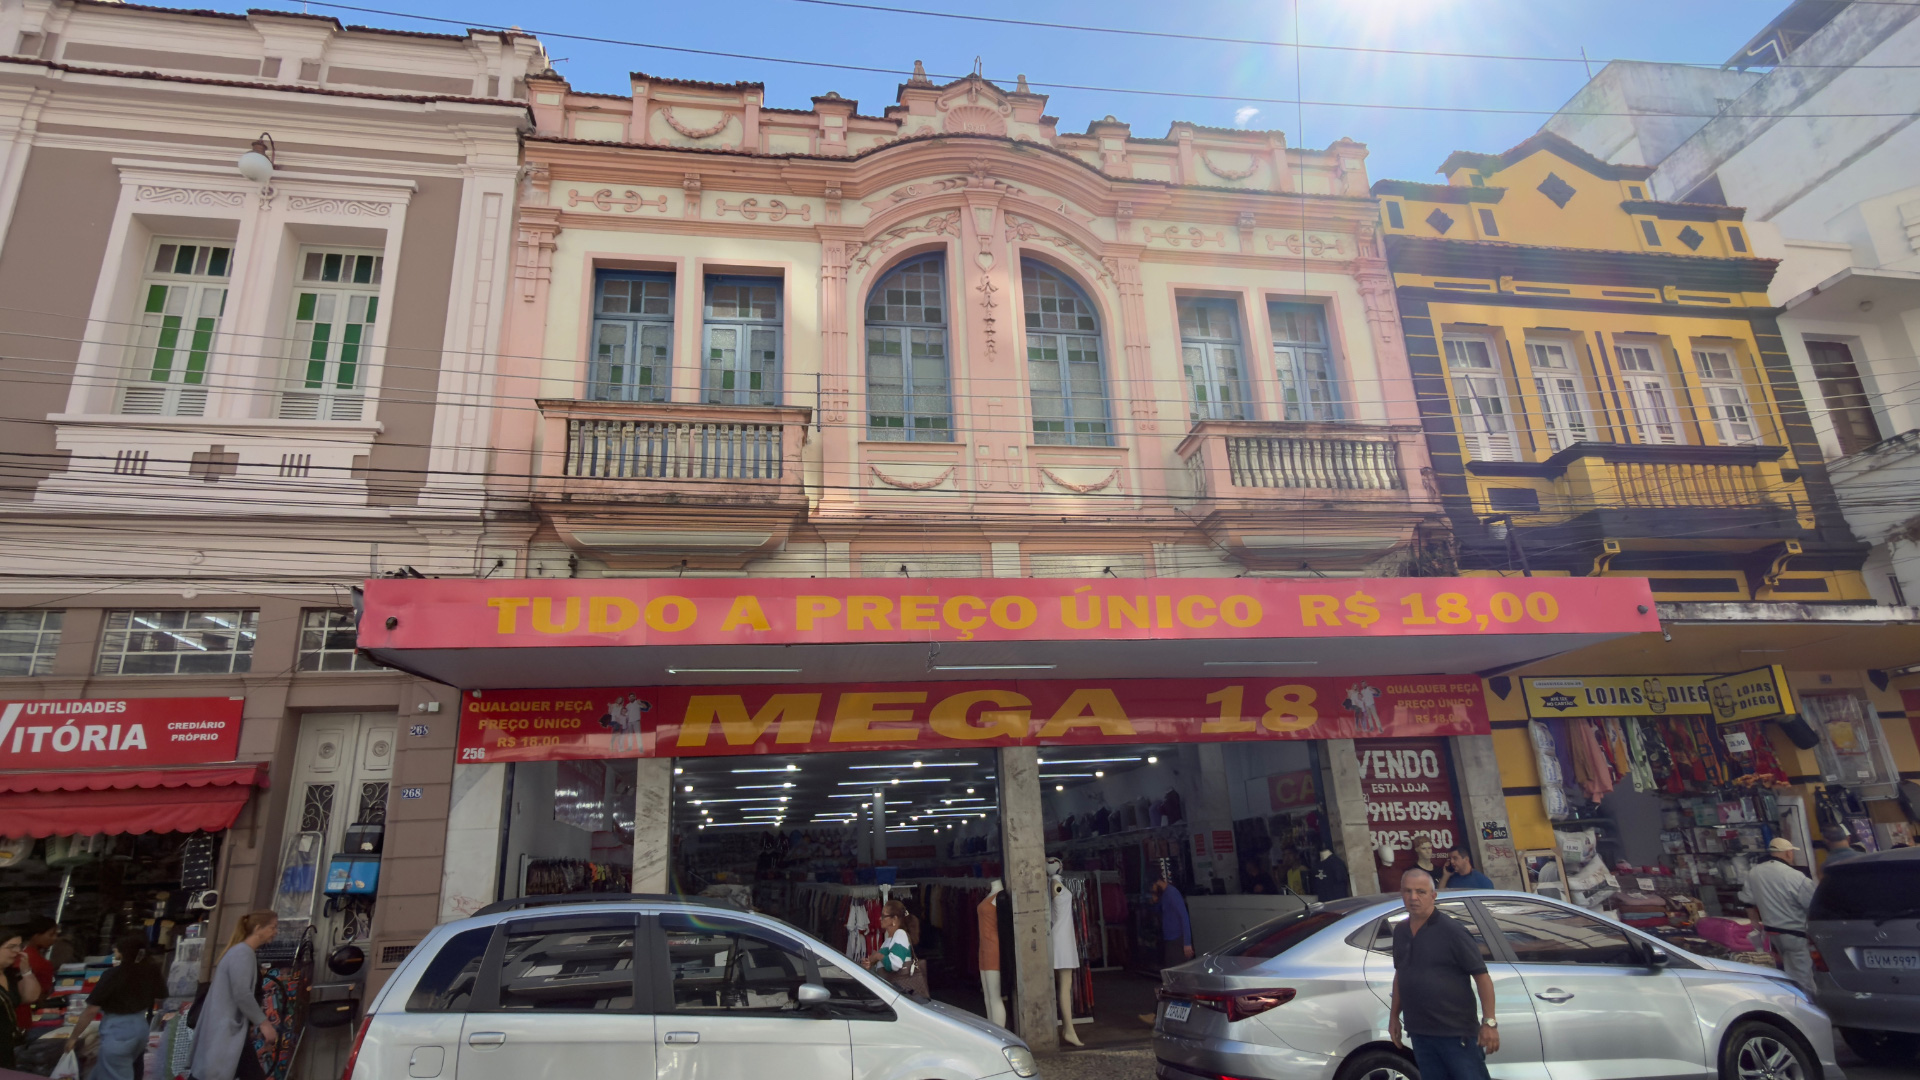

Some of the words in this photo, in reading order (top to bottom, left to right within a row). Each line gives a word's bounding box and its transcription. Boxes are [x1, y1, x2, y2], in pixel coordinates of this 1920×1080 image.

[487, 595, 698, 634] TUDO
[720, 595, 772, 632] A
[796, 594, 1038, 640] PREÇO
[1060, 585, 1263, 630] ÚNICO
[1300, 590, 1381, 629] R$
[1400, 591, 1560, 632] 18,00
[1386, 684, 1447, 695] QUALQUER
[1450, 683, 1479, 695] PEÇA
[1584, 687, 1643, 705] LOJAS
[1666, 685, 1710, 703] DIEG
[1736, 682, 1772, 697] LOJAS
[26, 701, 126, 714] UTILIDADES
[469, 701, 550, 713] QUALQUER
[555, 700, 593, 713] PEÇA
[1397, 699, 1435, 709] PREÇO
[1438, 697, 1473, 708] ÚNICO
[1739, 695, 1776, 710] DIEGO
[676, 689, 1138, 747] MEGA
[1200, 684, 1319, 734] 18
[1415, 714, 1430, 724] R$
[1432, 713, 1461, 725] 18,0
[167, 720, 226, 730] CREDIÁRIO
[478, 718, 529, 732] PREÇO
[533, 716, 581, 729] ÚNICO
[409, 725, 429, 736] 268
[171, 732, 219, 742] PRÓPRIO
[497, 736, 516, 748] R$
[462, 747, 486, 759] 256
[1359, 749, 1440, 779] VENDO
[403, 788, 421, 798] 268
[1371, 783, 1399, 793] ESTA
[1401, 782, 1429, 793] LOJA
[1365, 801, 1452, 821] 9115-0394
[1483, 821, 1497, 829] use
[1893, 956, 1917, 967] 9997
